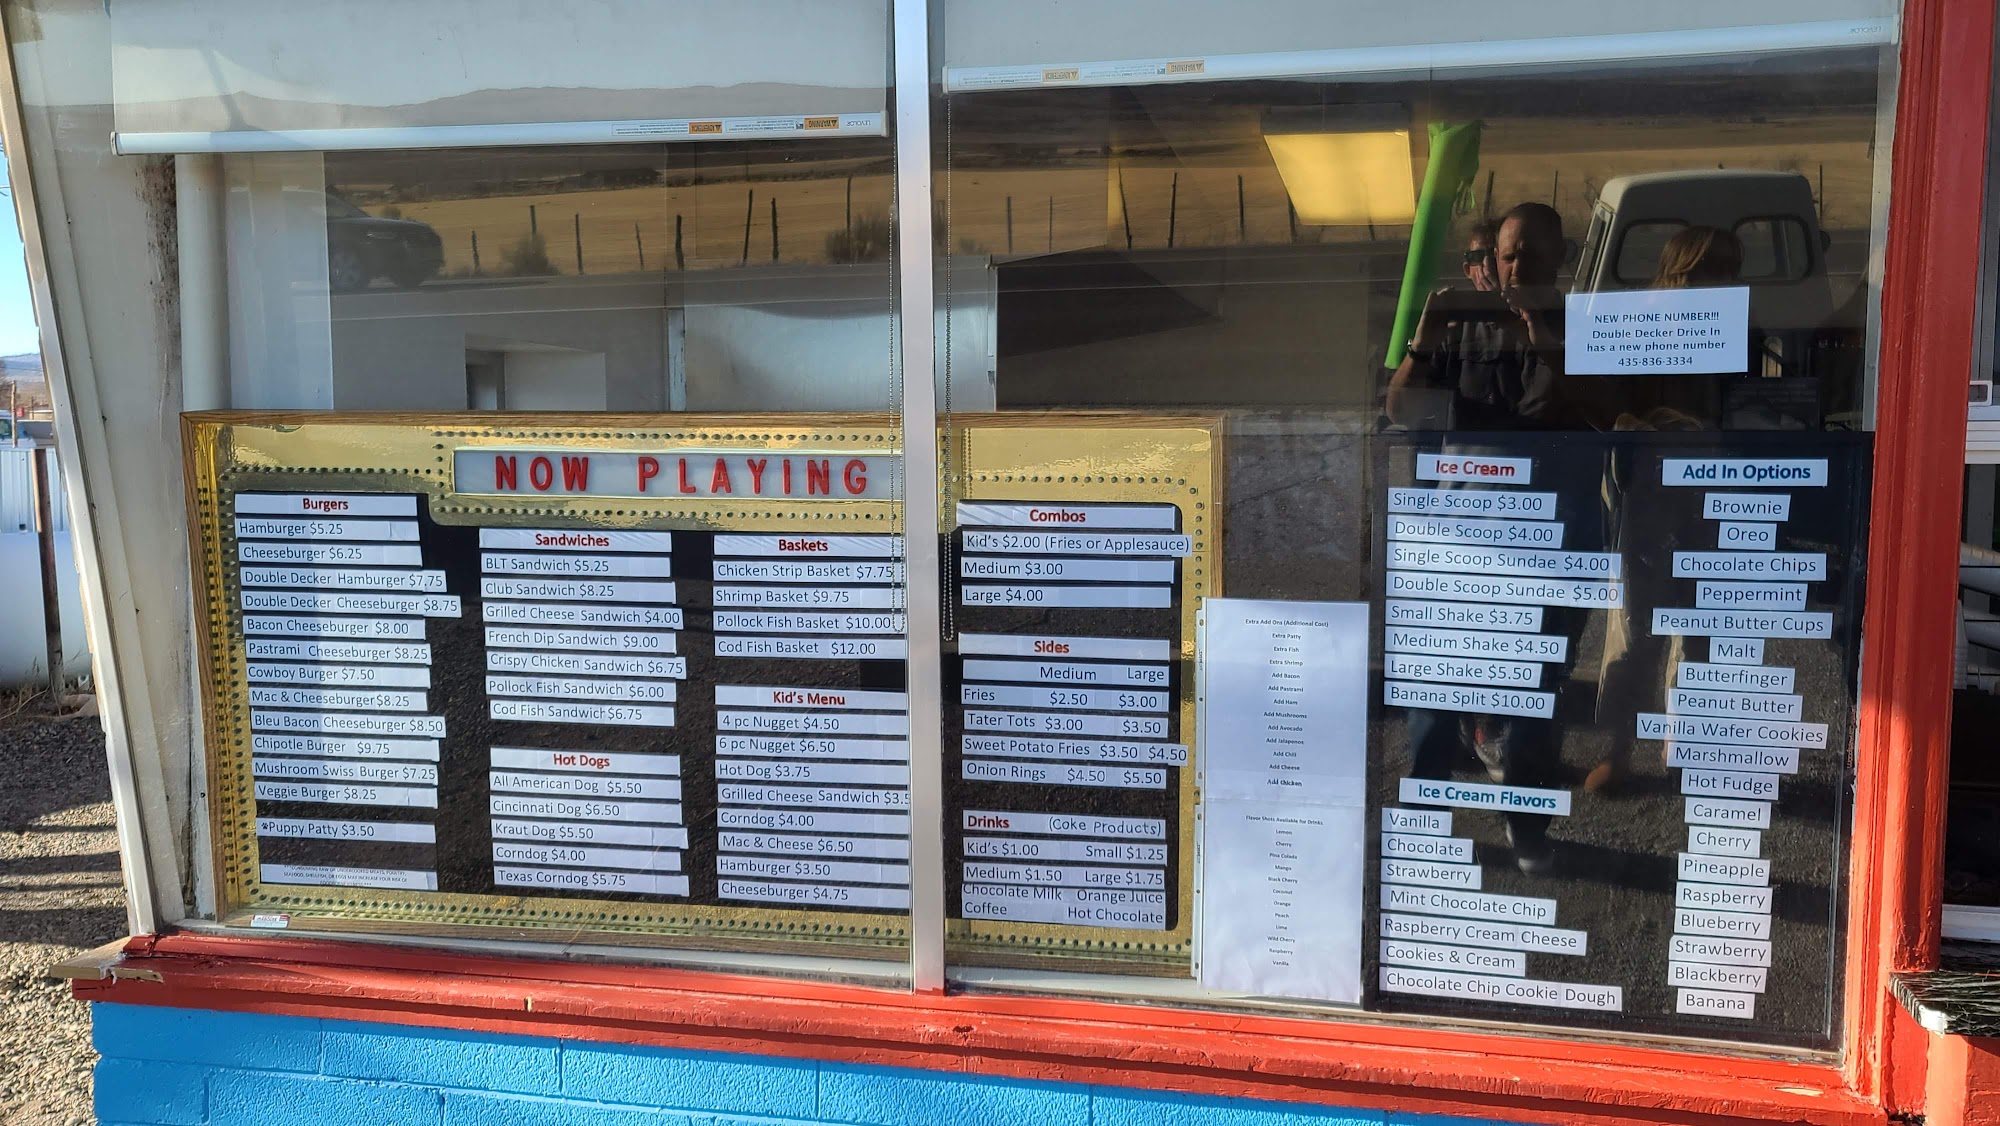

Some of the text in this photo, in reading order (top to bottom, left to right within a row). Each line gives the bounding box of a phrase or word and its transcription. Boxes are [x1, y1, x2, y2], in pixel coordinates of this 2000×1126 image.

[1595, 312, 1719, 323] NEW PHONE NUMBER!!!
[1592, 328, 1720, 338] Double Decker Drive In
[1587, 343, 1605, 352] has
[1645, 342, 1679, 352] phone
[1683, 341, 1725, 350] number
[1618, 357, 1693, 366] 435-836-3334
[496, 456, 867, 495] NOW PLAYING
[1436, 460, 1515, 476] Ice Cream
[1683, 465, 1811, 482] Add In Options
[303, 498, 348, 512] Burgers
[1394, 493, 1542, 512] Single Scoop $3.00
[1713, 500, 1782, 515] Brownie
[1030, 510, 1086, 522] Combos
[239, 522, 343, 536] Hamburger $5.25
[1727, 528, 1769, 541] Oreo
[535, 533, 609, 547] Sandwiches
[779, 539, 828, 551] Baskets
[244, 547, 362, 561] Cheeseburger $6.25
[486, 558, 609, 572] BLT Sandwich $5.25
[964, 562, 1063, 576] Medium $3.00
[245, 572, 443, 588] Double Decker Hamburger $7.75
[486, 583, 614, 597] Club Sandwich $8.25
[716, 590, 849, 604] Shrimp Basket $9.75
[965, 588, 1043, 603] Large $4.00
[1703, 587, 1802, 604] Peppermint
[1391, 605, 1533, 625] Small Shake $3.75
[247, 619, 409, 636] Bacon Cheeseburger $8.00
[489, 631, 658, 649] French Dip Sandwich $9.00
[718, 641, 876, 655] Cod Fish Basket $12.00
[1034, 641, 1069, 653] Sides
[1717, 644, 1756, 658] Malt
[490, 653, 683, 674] Crispy Chicken Sandwich $6.75
[248, 666, 374, 682] Cowboy Burger $7.50
[1040, 667, 1164, 682] Medium Large
[1686, 668, 1788, 687] Butterfinger
[807, 693, 845, 705] Menu
[964, 689, 1157, 708] Fries $2.50 $3.00
[1391, 687, 1545, 710] Banana Split $10.00
[254, 737, 389, 755] Chipotle Burger $9.75
[553, 754, 610, 769] Hot Dogs
[719, 765, 810, 778] Hot Dog $3.75
[967, 763, 1161, 784] Onion Rings $4.50 $5.50
[258, 785, 376, 800] Veggie Burger $8.25
[494, 776, 641, 794] All American Dog $5.50
[1688, 775, 1773, 794] Hot Fudge
[1419, 784, 1556, 809] Ice Cream Flavors
[1693, 804, 1761, 821] Caramel
[968, 815, 1161, 835] Drinks (Coke Products)
[1389, 813, 1440, 829] Vanilla
[269, 822, 374, 837] Puppy Patty $3.50
[495, 823, 593, 839] Kraut Dog $5.50
[723, 835, 853, 852] Mac & Cheese $6.50
[1002, 843, 1039, 856] $1.00
[1086, 846, 1121, 859] Small
[1126, 846, 1164, 860] $1.25
[1387, 839, 1463, 856] Chocolate
[496, 847, 585, 861] Corndog $4.00
[720, 859, 830, 876] Hamburger $3.50
[1386, 864, 1471, 883] Strawberry
[1684, 860, 1764, 879] Pineapple
[721, 883, 848, 900] Cheeseburger $4.75
[1683, 888, 1765, 908] Raspberry
[965, 902, 1163, 923] Coffee Hot Chocolate
[1386, 946, 1515, 968] Cookies & Cream
[1686, 994, 1745, 1010] Banana
